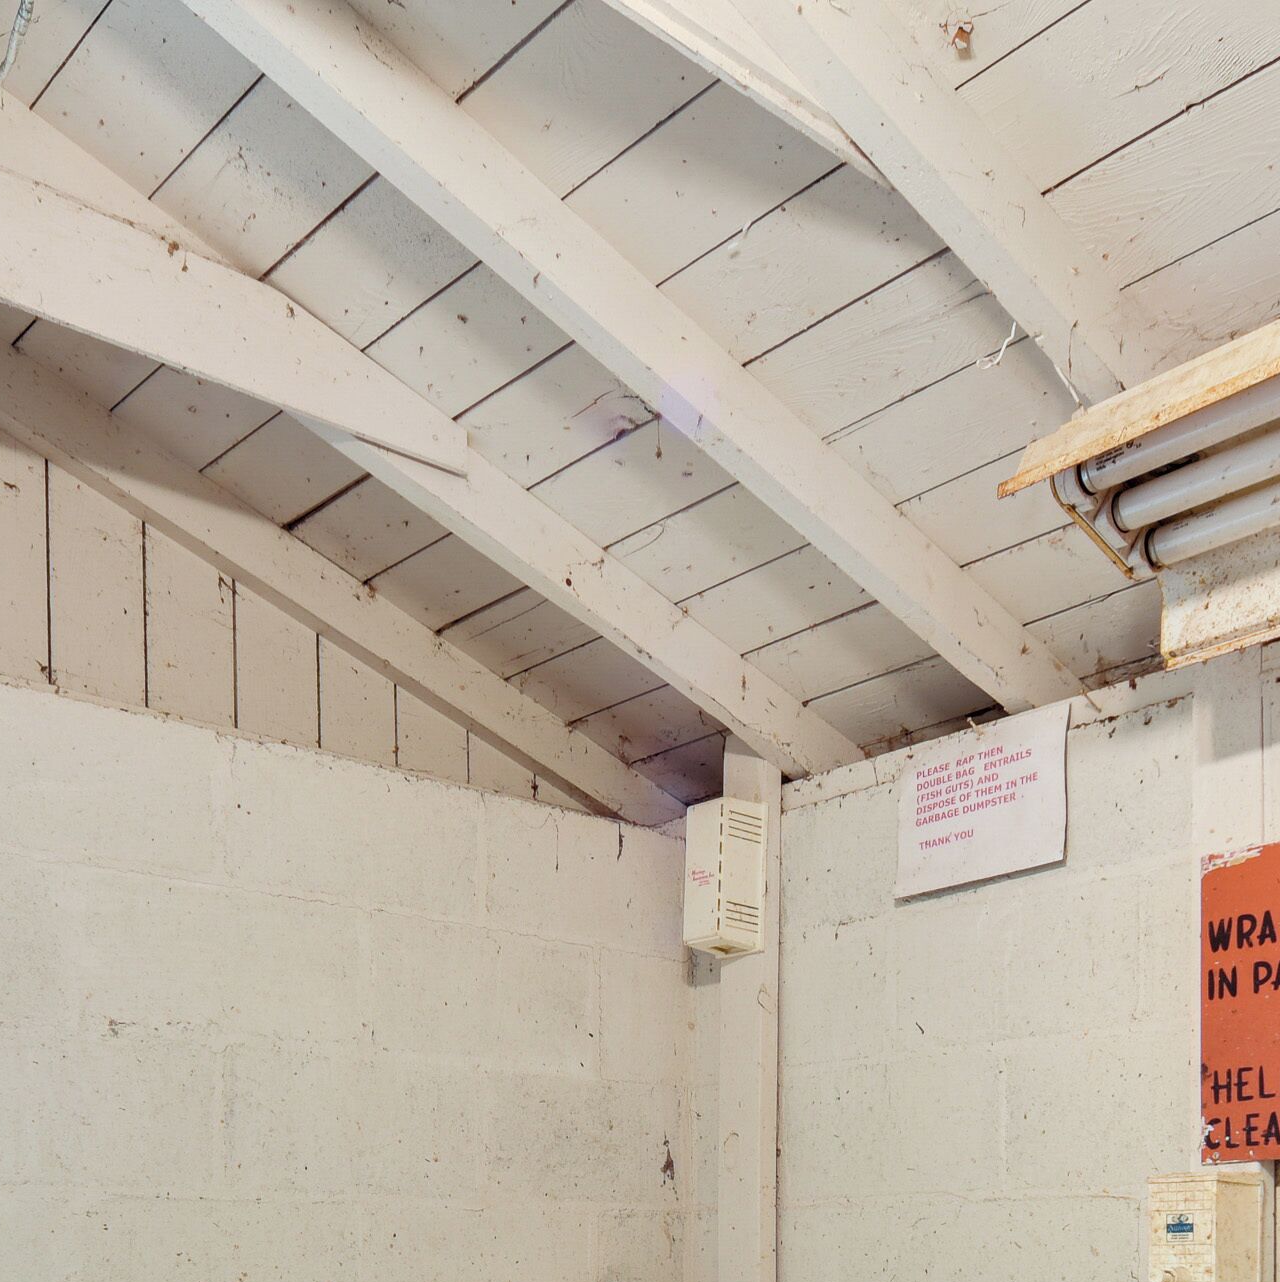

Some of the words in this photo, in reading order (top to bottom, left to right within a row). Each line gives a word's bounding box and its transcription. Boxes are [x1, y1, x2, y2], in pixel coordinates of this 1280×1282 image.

[917, 763, 950, 779] PLEASE
[956, 755, 975, 767] RAP
[978, 746, 1003, 760] THEN
[917, 775, 952, 791] DOUBLE
[956, 767, 975, 779] BAG
[984, 749, 1032, 771] ENTRAILS
[916, 799, 956, 815] DISPOSE
[959, 793, 971, 803] OF
[975, 785, 1002, 798] THEM
[1005, 781, 1017, 790] IN
[1020, 772, 1038, 785] THE
[917, 788, 942, 805] (FISH
[945, 780, 974, 795] GUTS)
[977, 773, 999, 785] AND
[916, 809, 959, 827] GARBAGE
[963, 793, 1016, 814] DUMPSTER
[920, 834, 951, 850] THANK
[954, 830, 974, 842] YOU
[1207, 966, 1238, 1000] IN
